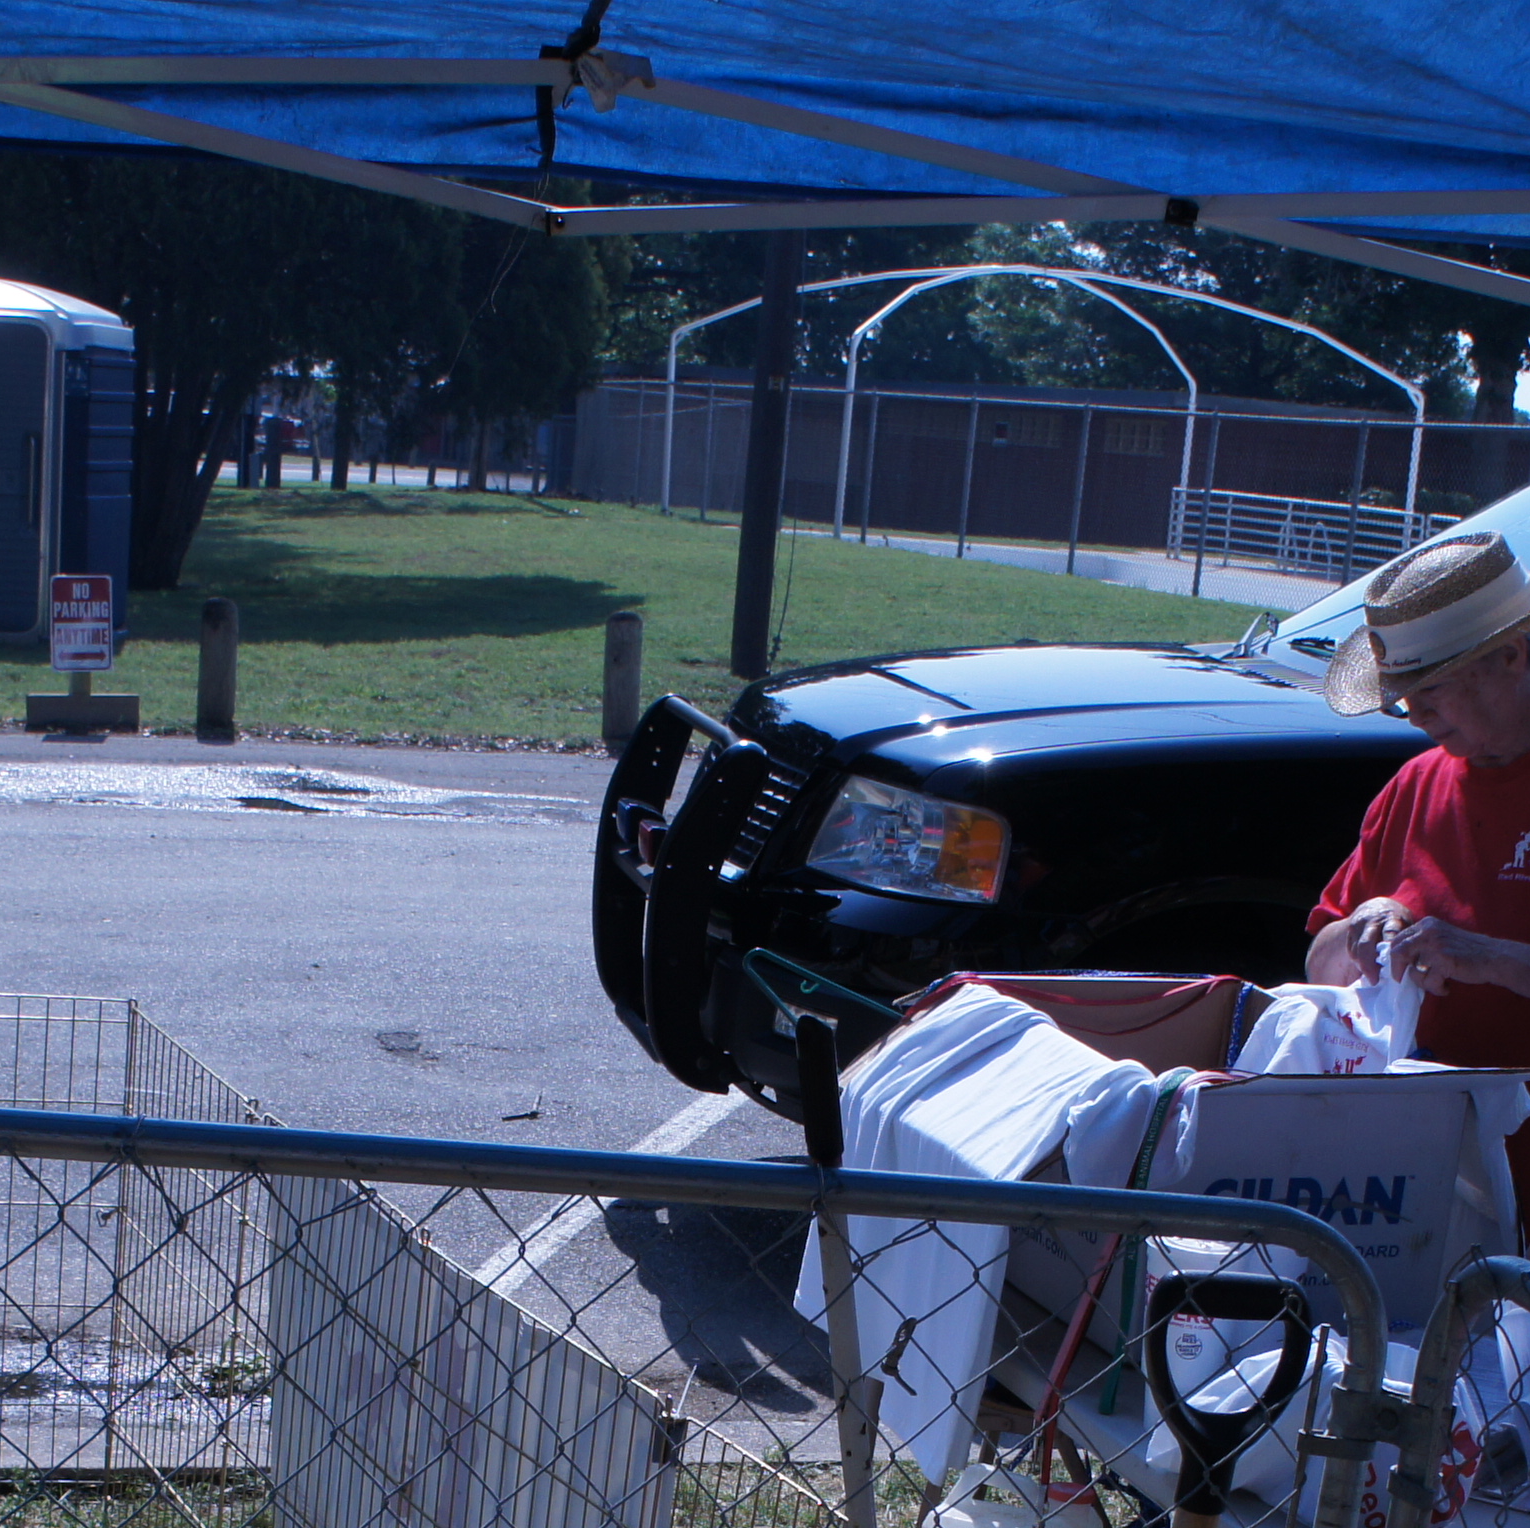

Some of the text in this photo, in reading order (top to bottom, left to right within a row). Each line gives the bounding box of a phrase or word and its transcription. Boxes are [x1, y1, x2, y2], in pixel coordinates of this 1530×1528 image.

[72, 583, 89, 600] NO
[53, 601, 109, 618] PARKING
[55, 628, 109, 645] ANYTIME
